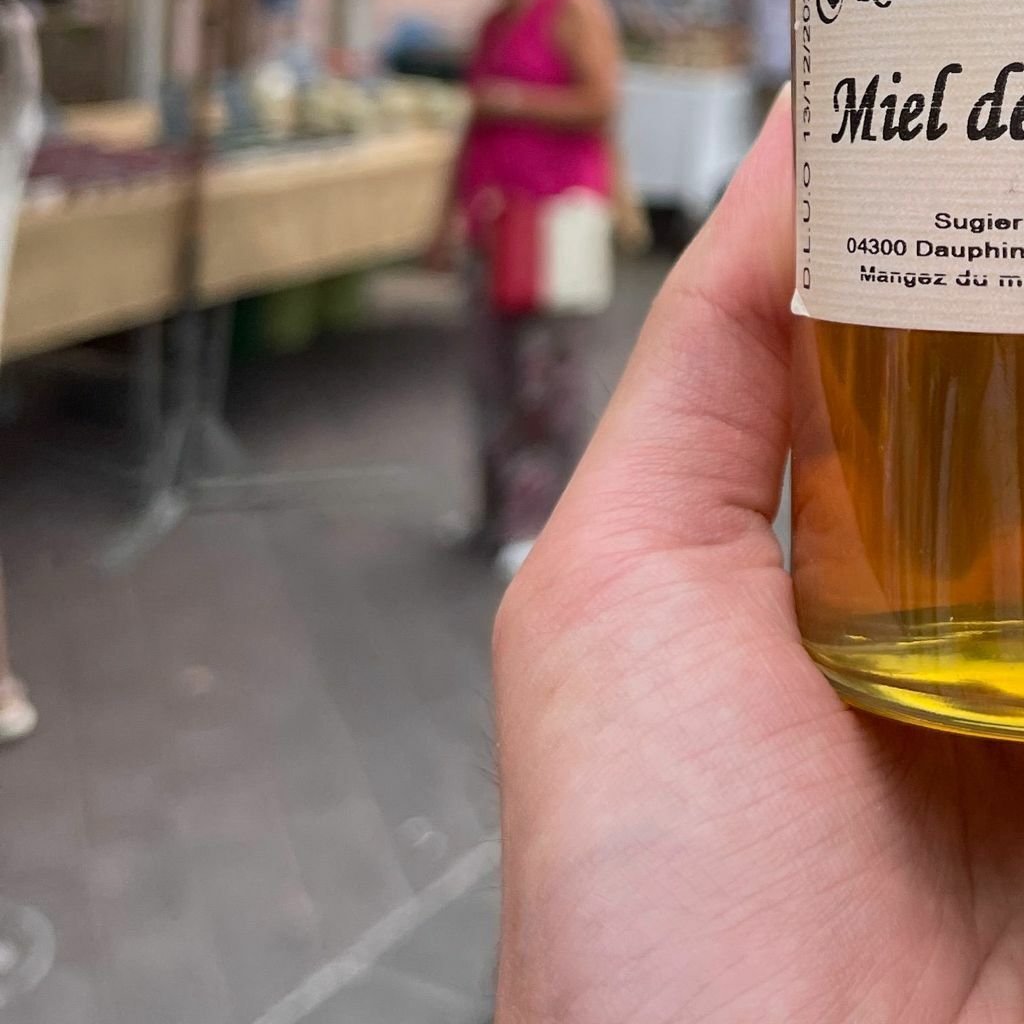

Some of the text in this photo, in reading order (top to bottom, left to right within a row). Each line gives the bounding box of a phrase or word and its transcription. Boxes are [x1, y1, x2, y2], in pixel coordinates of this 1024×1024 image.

[830, 62, 963, 145] Miel
[934, 212, 1024, 234] Sugier
[846, 236, 908, 257] 04300
[860, 264, 948, 289] Mangez
[955, 269, 989, 288] du
